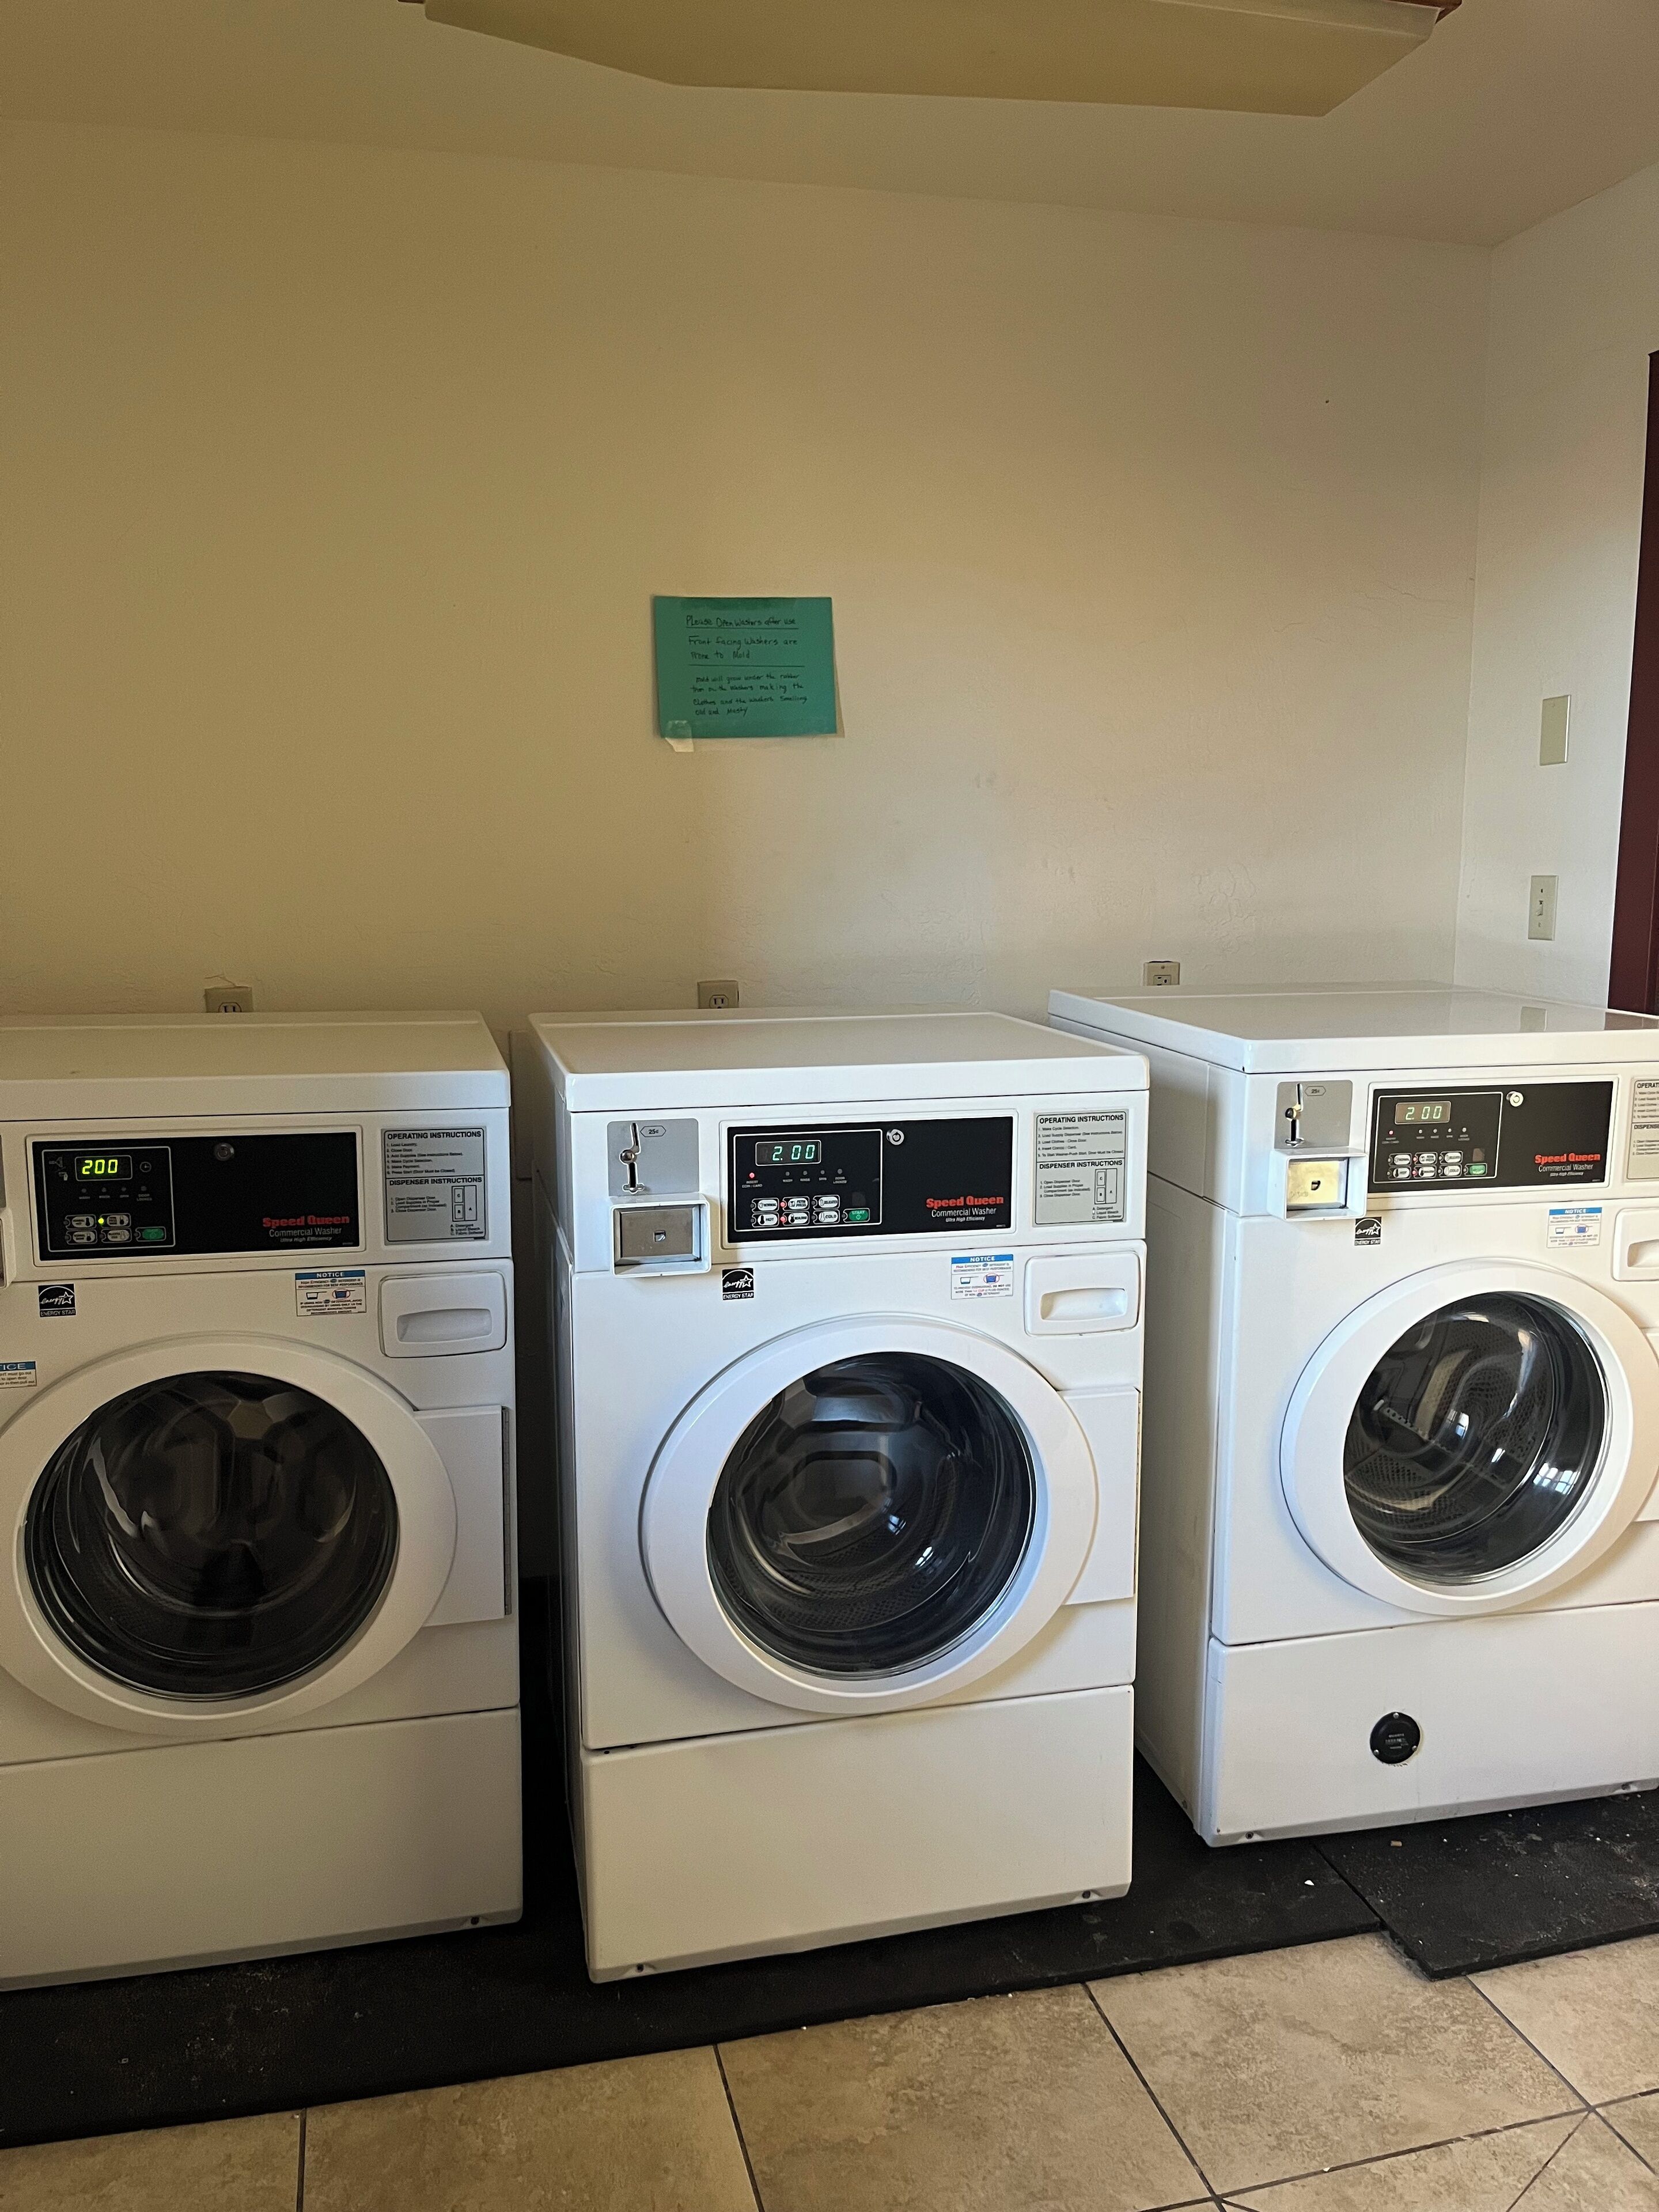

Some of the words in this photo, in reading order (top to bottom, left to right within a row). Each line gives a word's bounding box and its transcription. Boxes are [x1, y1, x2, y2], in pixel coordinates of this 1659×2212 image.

[716, 617, 733, 627] Open
[764, 616, 781, 626] after
[688, 635, 711, 646] Front
[714, 650, 724, 659] to
[733, 650, 751, 659] Mold
[726, 676, 742, 684] grow
[709, 707, 719, 715] and
[1078, 1114, 1123, 1122] INSTRUCTIONS
[430, 1131, 482, 1139] INSTRUCTIONS
[772, 1145, 815, 1161] 2.00
[1535, 1153, 1567, 1165] Speed
[1568, 1153, 1601, 1162] Queen
[926, 1196, 964, 1209] Speed
[965, 1195, 1004, 1205] Queen
[931, 1208, 970, 1217] Commercial
[263, 1215, 305, 1229] Speed
[308, 1215, 350, 1225] Queen
[269, 1228, 313, 1237] Commercial
[315, 1227, 342, 1235] Washer
